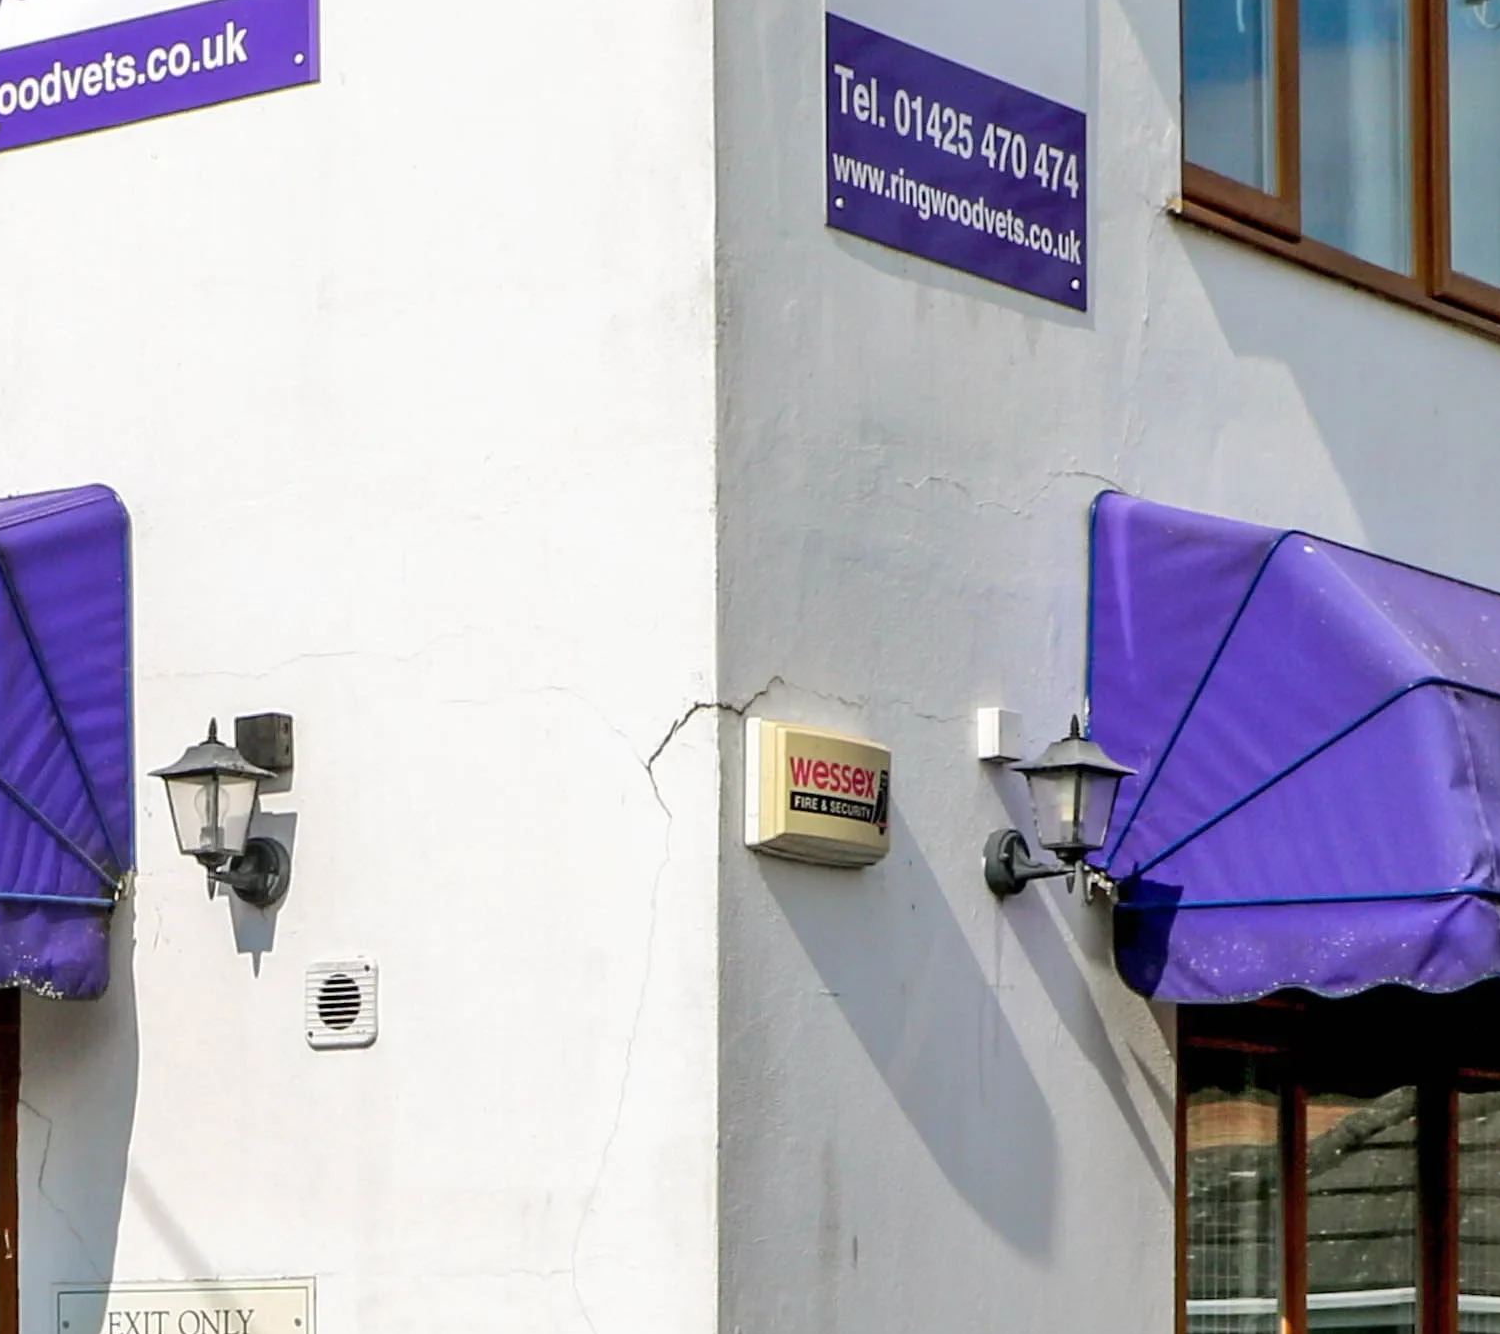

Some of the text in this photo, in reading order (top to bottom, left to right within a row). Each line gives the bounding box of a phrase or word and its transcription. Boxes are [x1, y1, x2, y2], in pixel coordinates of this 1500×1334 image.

[835, 63, 1080, 198] Tel. 01425 470 474
[833, 153, 1082, 265] www.ringwoodvets.co.uk
[789, 756, 876, 799] wessex
[794, 794, 871, 819] FIRE & SECURITY
